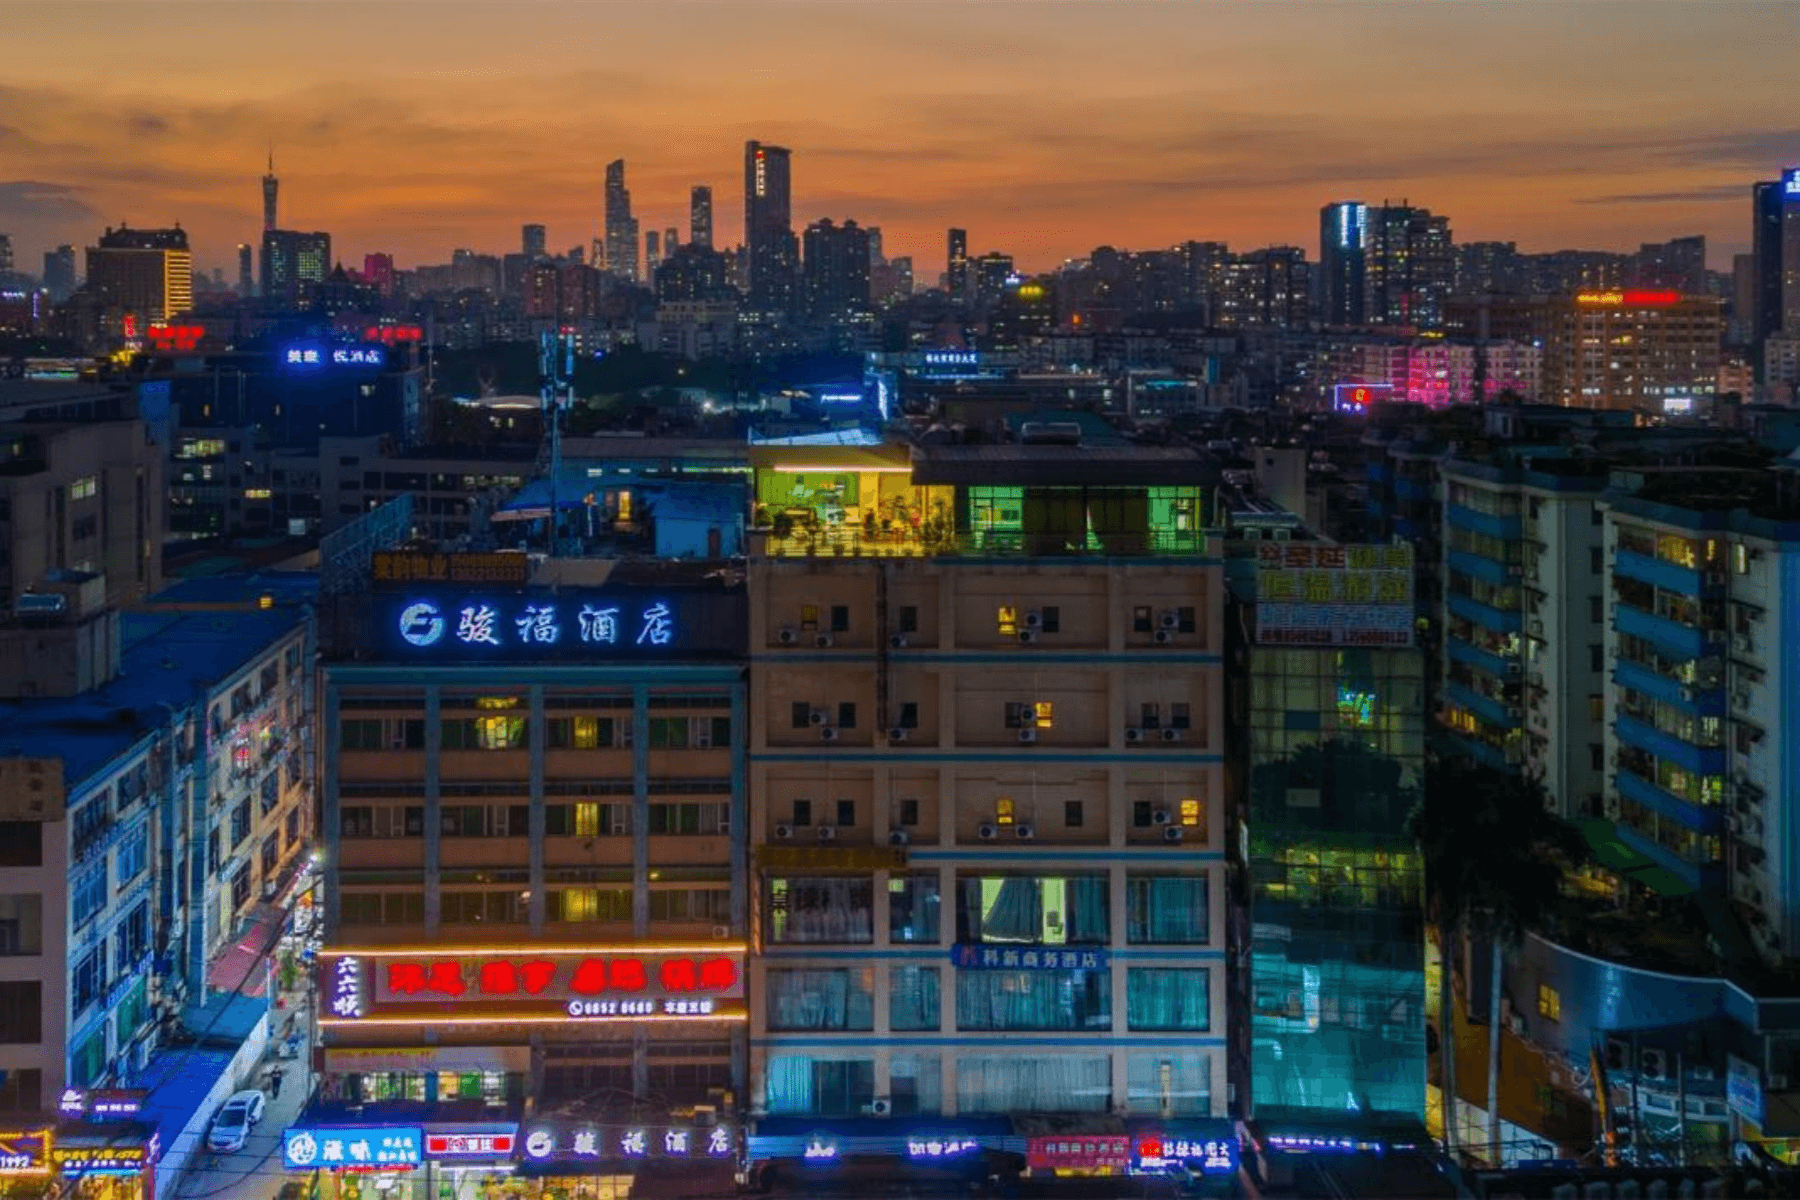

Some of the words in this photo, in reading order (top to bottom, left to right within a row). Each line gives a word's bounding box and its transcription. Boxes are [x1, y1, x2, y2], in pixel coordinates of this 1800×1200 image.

[455, 604, 674, 645] 骏福酒店
[982, 948, 1098, 968] 科新商务酒店
[573, 1128, 732, 1156] 骏福酒店
